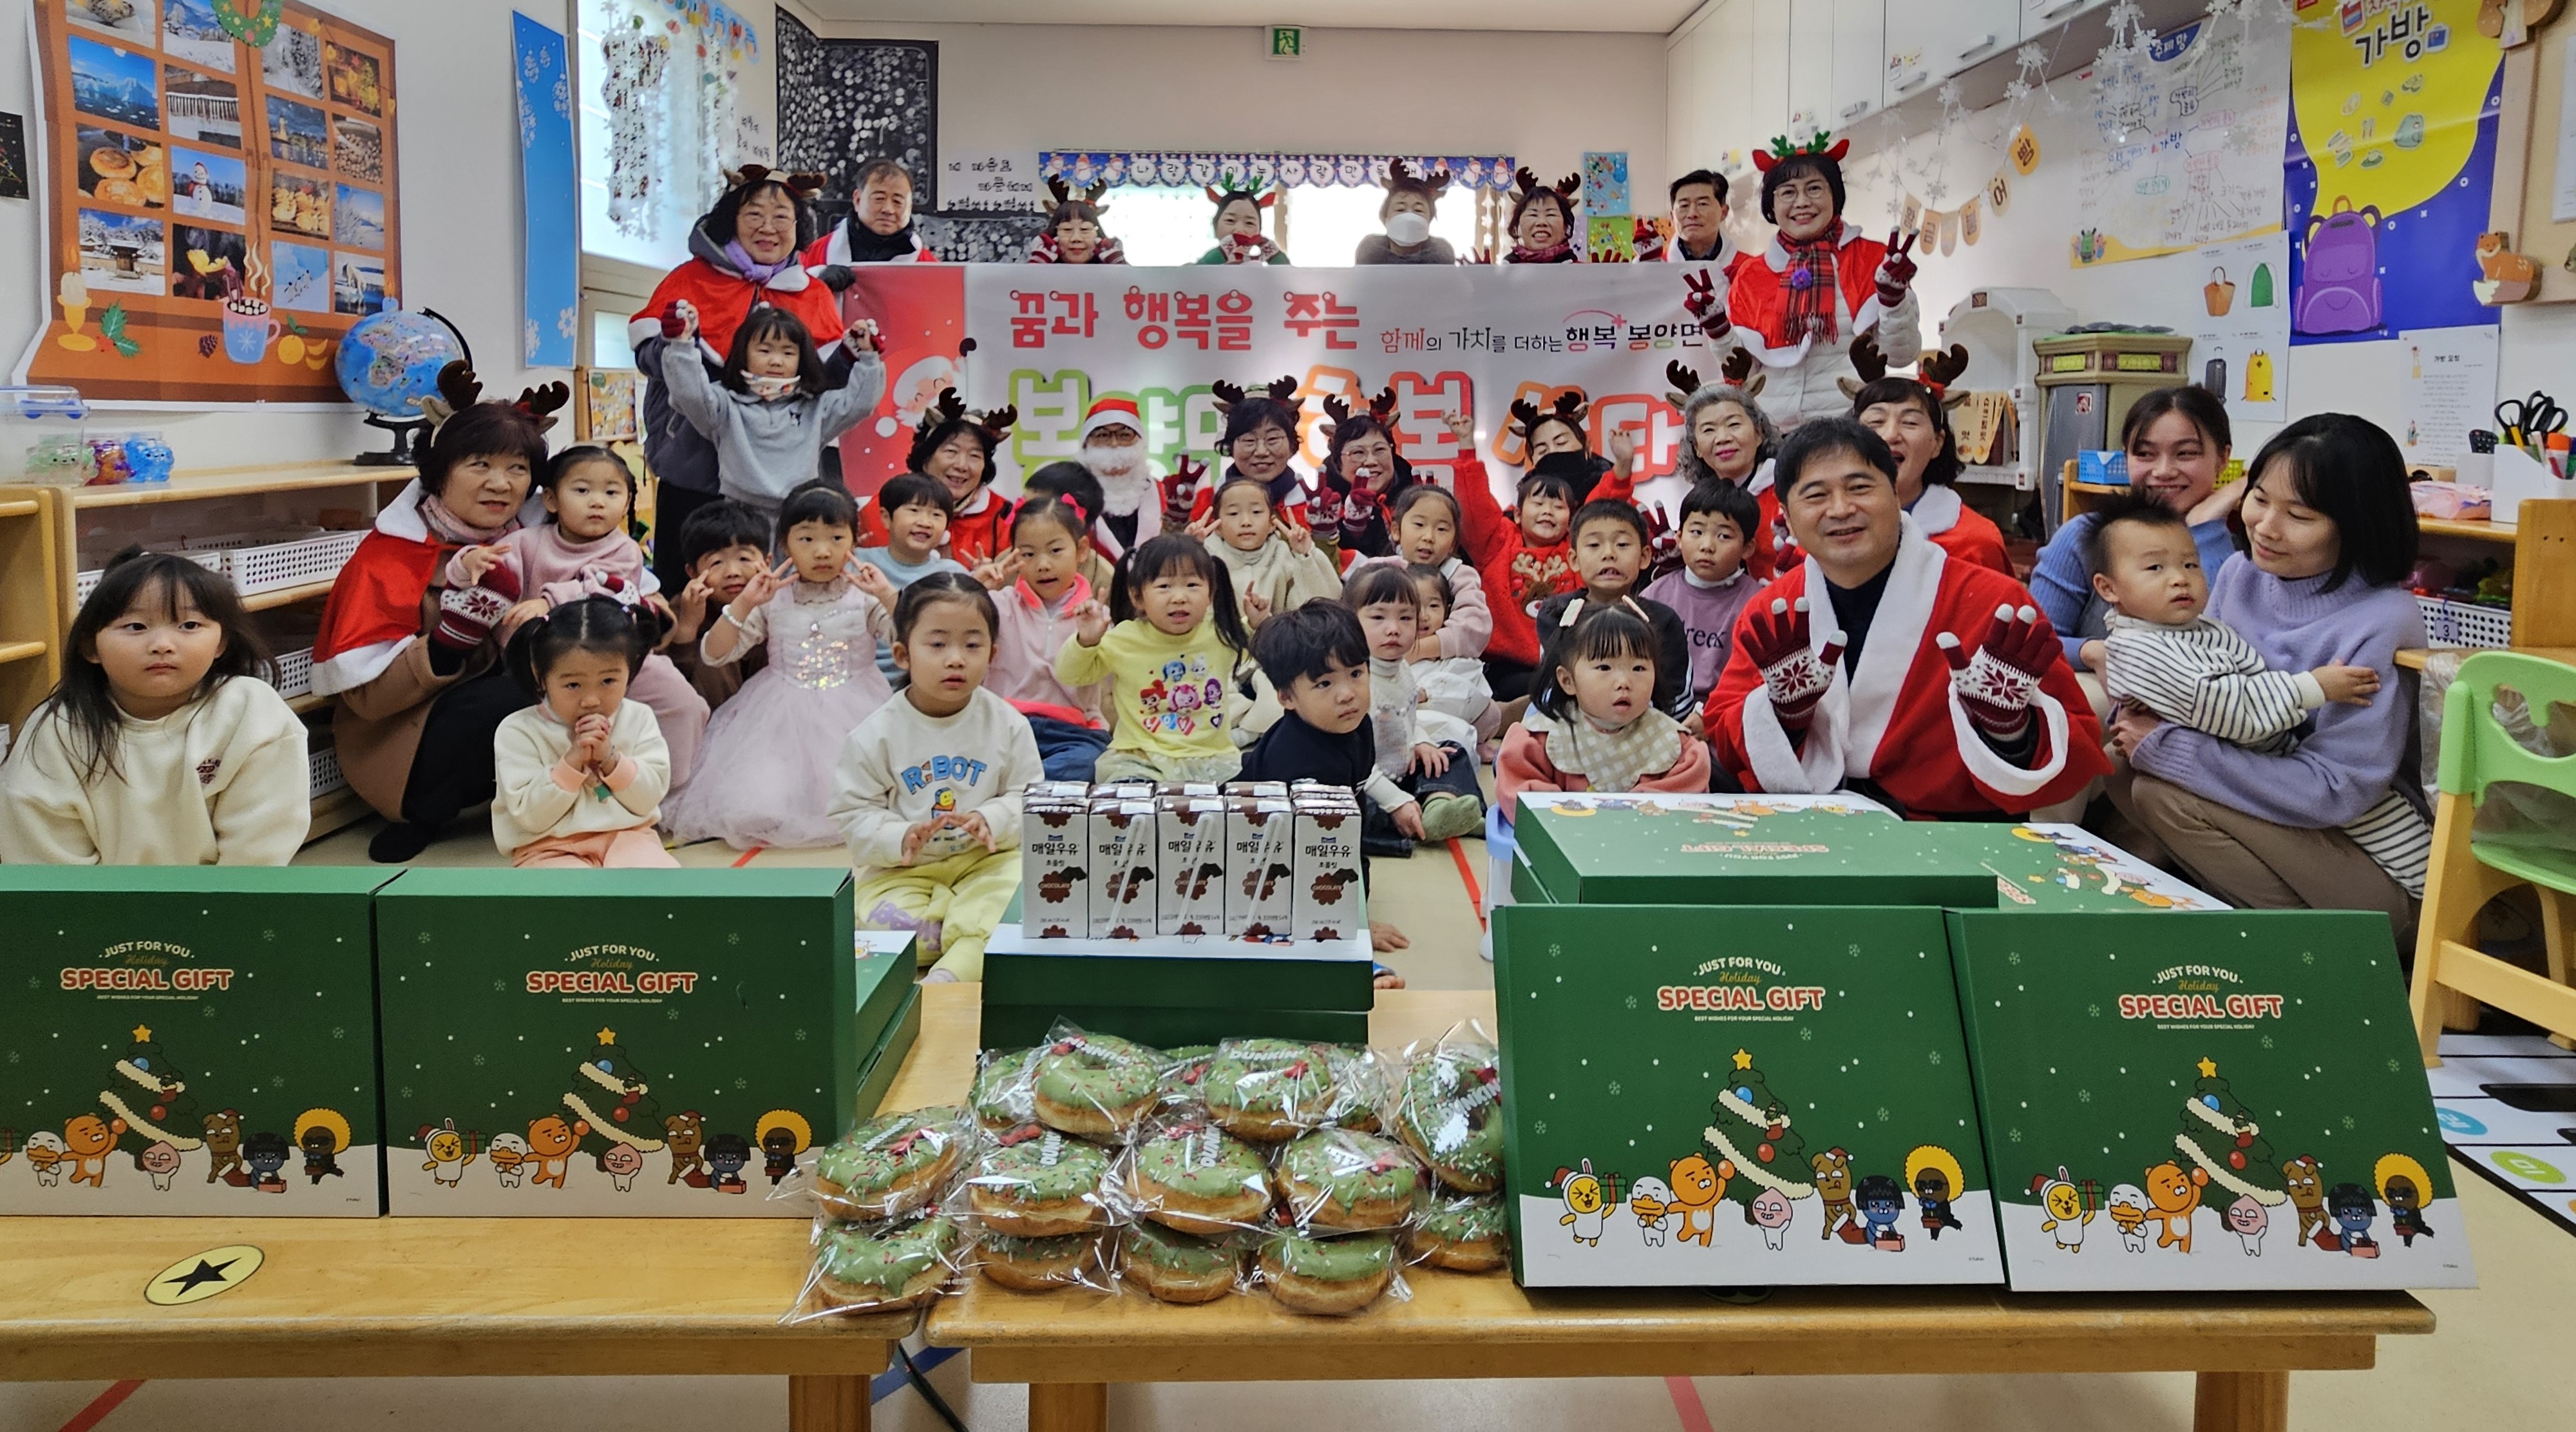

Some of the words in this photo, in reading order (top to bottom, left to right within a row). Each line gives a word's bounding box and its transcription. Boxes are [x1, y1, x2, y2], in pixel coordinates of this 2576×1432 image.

[2355, 6, 2429, 65] 가방
[2160, 131, 2183, 151] 가방
[1010, 289, 1098, 348] 꿈과
[1124, 285, 1253, 351] 행복을
[1283, 290, 1359, 350] 주는
[1380, 327, 1441, 353] 함께의
[1448, 327, 1506, 353] 가치를
[1515, 334, 1562, 352] 더하는
[1566, 325, 1617, 352] 행복
[1628, 323, 1704, 351] 봉양면
[1681, 620, 1728, 649] reek
[1032, 843, 1079, 855] 매일우유
[1305, 845, 1352, 858] 매일우유
[104, 942, 134, 958] JUST
[136, 940, 162, 951] FOR
[164, 942, 191, 958] YOU
[570, 946, 600, 962] JUST
[602, 944, 627, 955] FOR
[629, 946, 656, 961] YOU
[590, 958, 634, 970] Holiday
[1698, 958, 1727, 976] JUST
[1728, 957, 1753, 968] FOR
[1755, 959, 1781, 975] YOU
[61, 968, 171, 990] SPECIAL
[172, 968, 234, 990] GIFT
[526, 971, 635, 993] SPECIAL
[637, 971, 698, 993] GIFT
[1719, 970, 1762, 985] Holiday
[2157, 966, 2184, 984] JUST
[2186, 965, 2210, 976] FOR
[2211, 967, 2238, 983] YOU
[2177, 979, 2220, 993] Holiday
[1657, 986, 1766, 1011] SPECIAL
[1766, 986, 1826, 1011] GIFT
[2119, 994, 2226, 1019] SPECIAL
[2226, 995, 2284, 1019] GIFT
